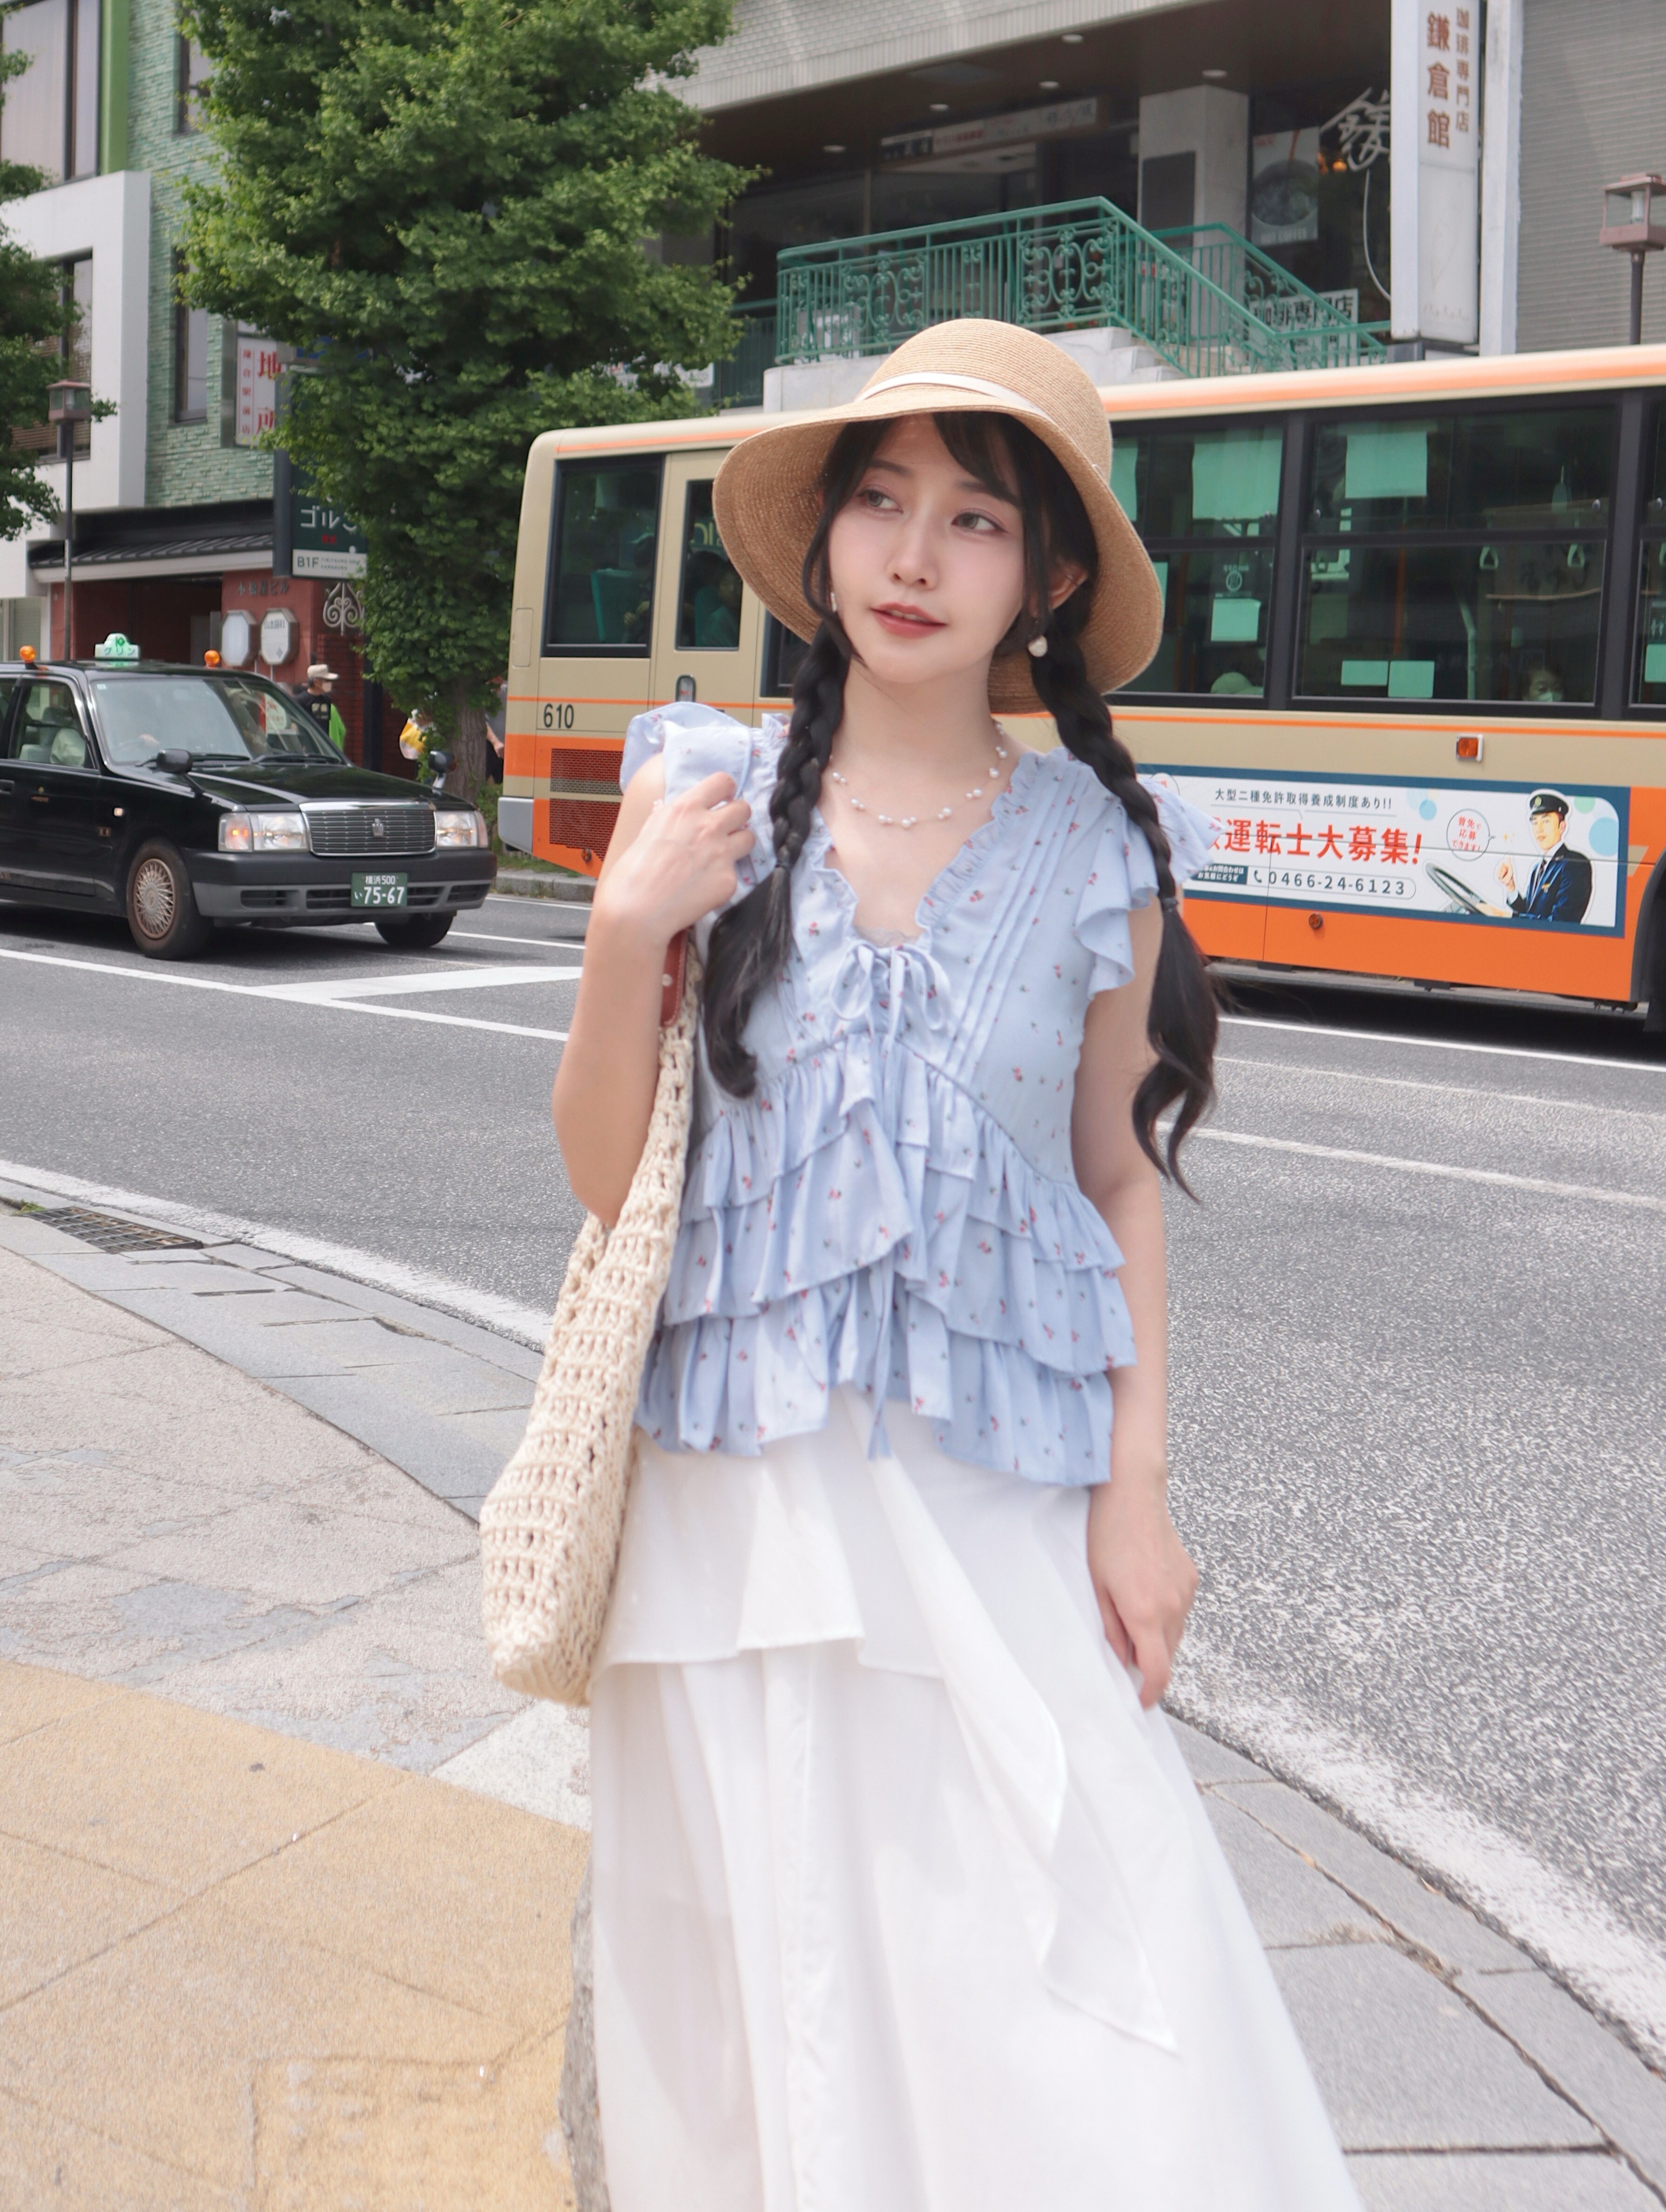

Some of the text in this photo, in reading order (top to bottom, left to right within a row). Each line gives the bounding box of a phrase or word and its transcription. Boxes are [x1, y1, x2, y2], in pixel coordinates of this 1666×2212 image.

[1426, 10, 1451, 148] 鎌倉館
[1456, 7, 1470, 133] 珈琲専門店
[297, 556, 319, 568] B1F
[543, 703, 574, 729] 610
[1214, 788, 1392, 809] 大型二種免許取得養成制度あり!!
[1209, 817, 1423, 865] 運転士大募集!
[353, 886, 405, 905] い 75-67
[1268, 870, 1405, 896] 0466-24-6123
